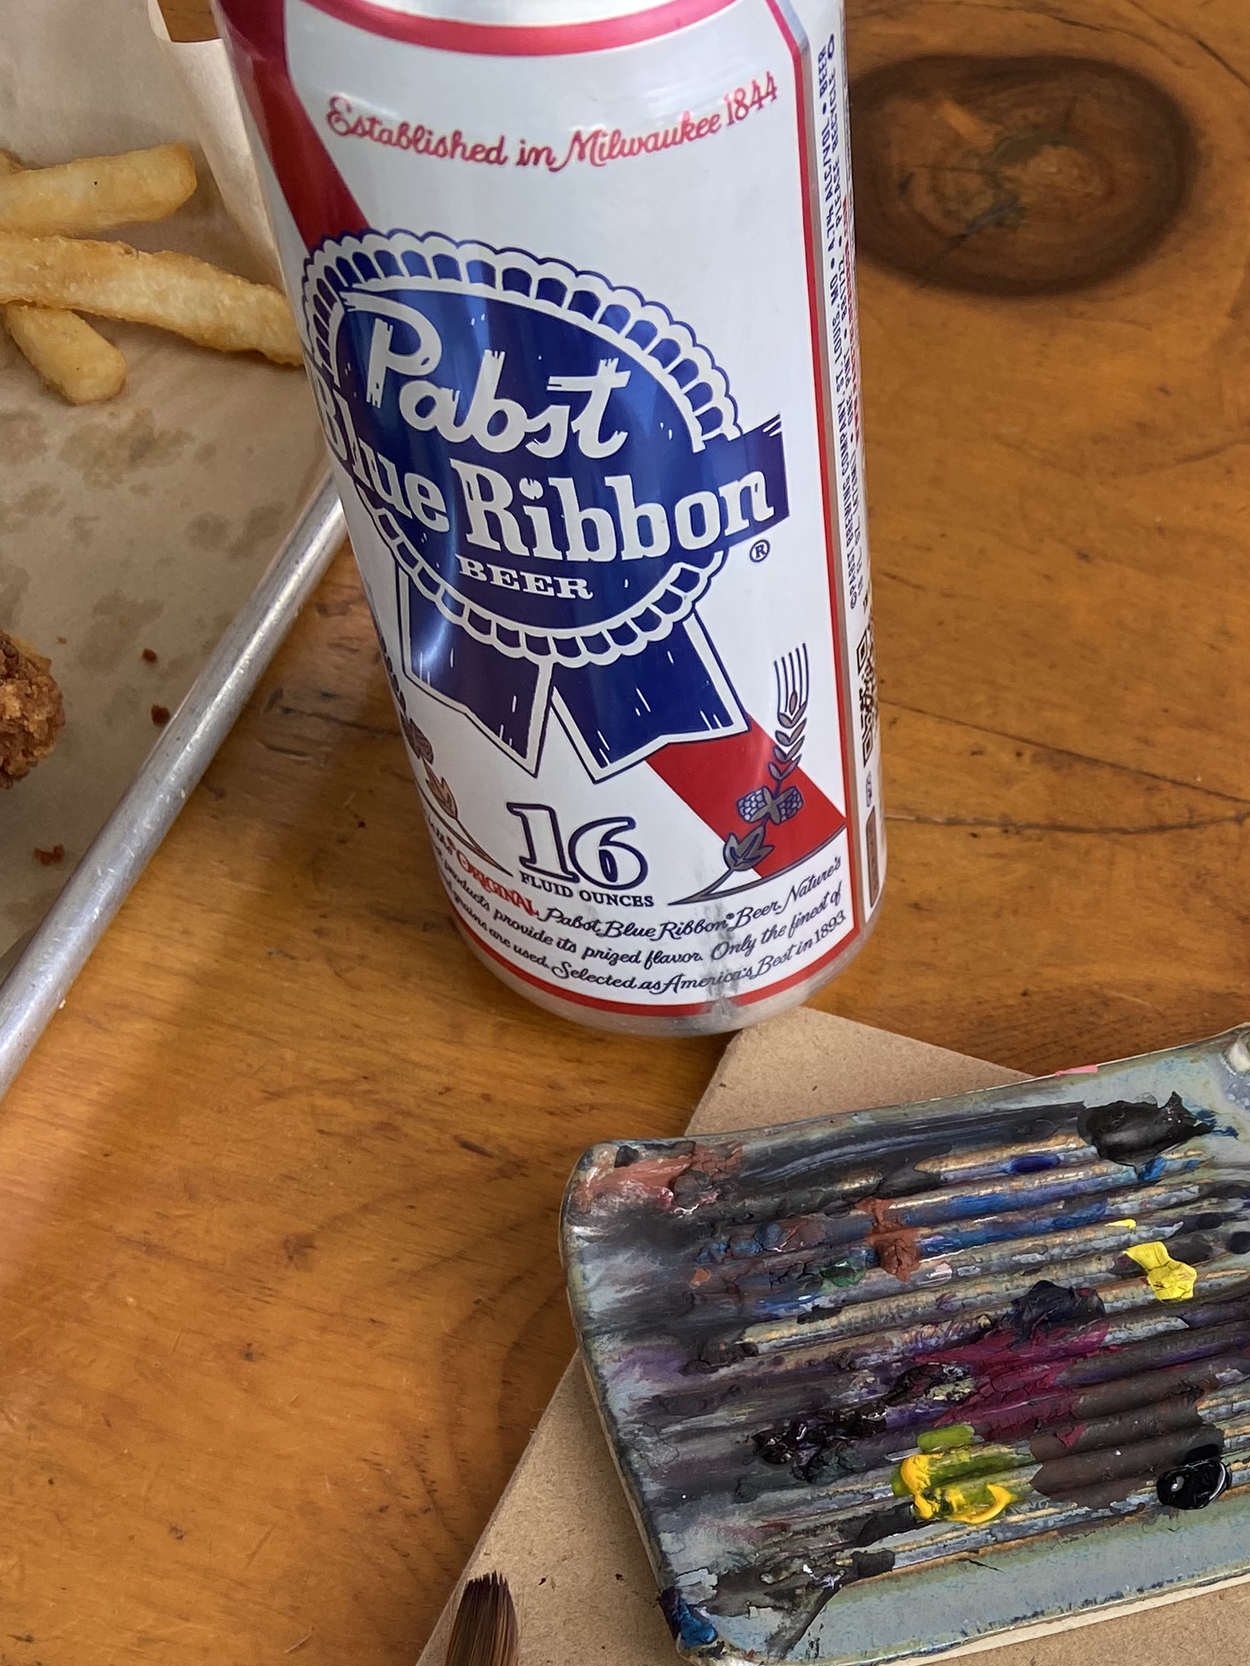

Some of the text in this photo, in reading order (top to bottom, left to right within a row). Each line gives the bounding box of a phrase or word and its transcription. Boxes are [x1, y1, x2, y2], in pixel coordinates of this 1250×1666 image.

[818, 45, 828, 99] BEER
[326, 71, 779, 173] Established in Milwaukee 1844
[828, 67, 839, 154] RECYCLE
[821, 117, 834, 203] ALC/VOL
[832, 155, 842, 228] PLEASE
[829, 272, 839, 307] MO
[339, 291, 631, 459] Pabst
[312, 371, 775, 562] Blue Ribbon
[843, 474, 854, 548] BREWING
[454, 553, 594, 600] BEER
[505, 801, 649, 891] 16
[444, 859, 491, 912] products
[493, 908, 554, 945] provide
[555, 936, 578, 954] its
[581, 945, 642, 968] prized
[710, 934, 756, 961] Only
[761, 921, 787, 942] the
[787, 895, 830, 940] finest
[829, 881, 843, 907] of
[456, 849, 540, 917] ORIGINAL
[537, 907, 602, 934] Pabst
[600, 919, 656, 940] Blue
[779, 856, 843, 914] Nature's
[519, 870, 655, 908] FLUID OUNCES
[488, 928, 511, 948] are
[748, 943, 796, 980] Best
[795, 937, 814, 956] in
[551, 960, 638, 990] Selected
[638, 978, 661, 992] as
[649, 964, 754, 996] America's
